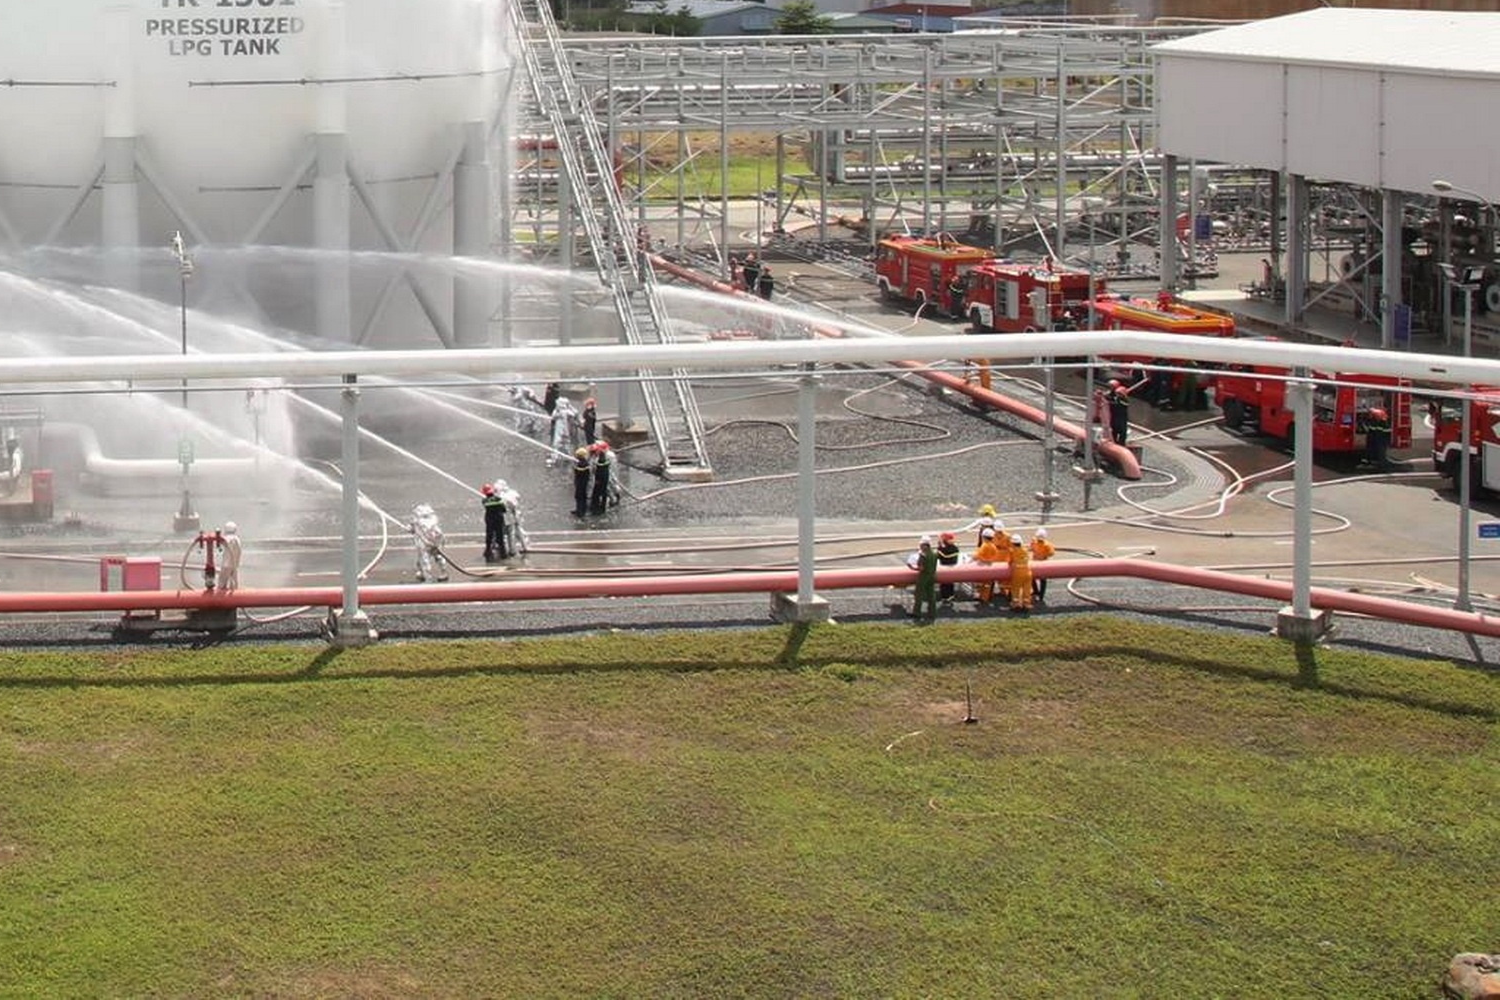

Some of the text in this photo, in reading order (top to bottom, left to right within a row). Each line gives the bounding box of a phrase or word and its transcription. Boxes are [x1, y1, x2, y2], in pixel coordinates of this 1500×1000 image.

[146, 17, 305, 36] PRESSURIZED
[169, 38, 280, 56] LPG TANK
